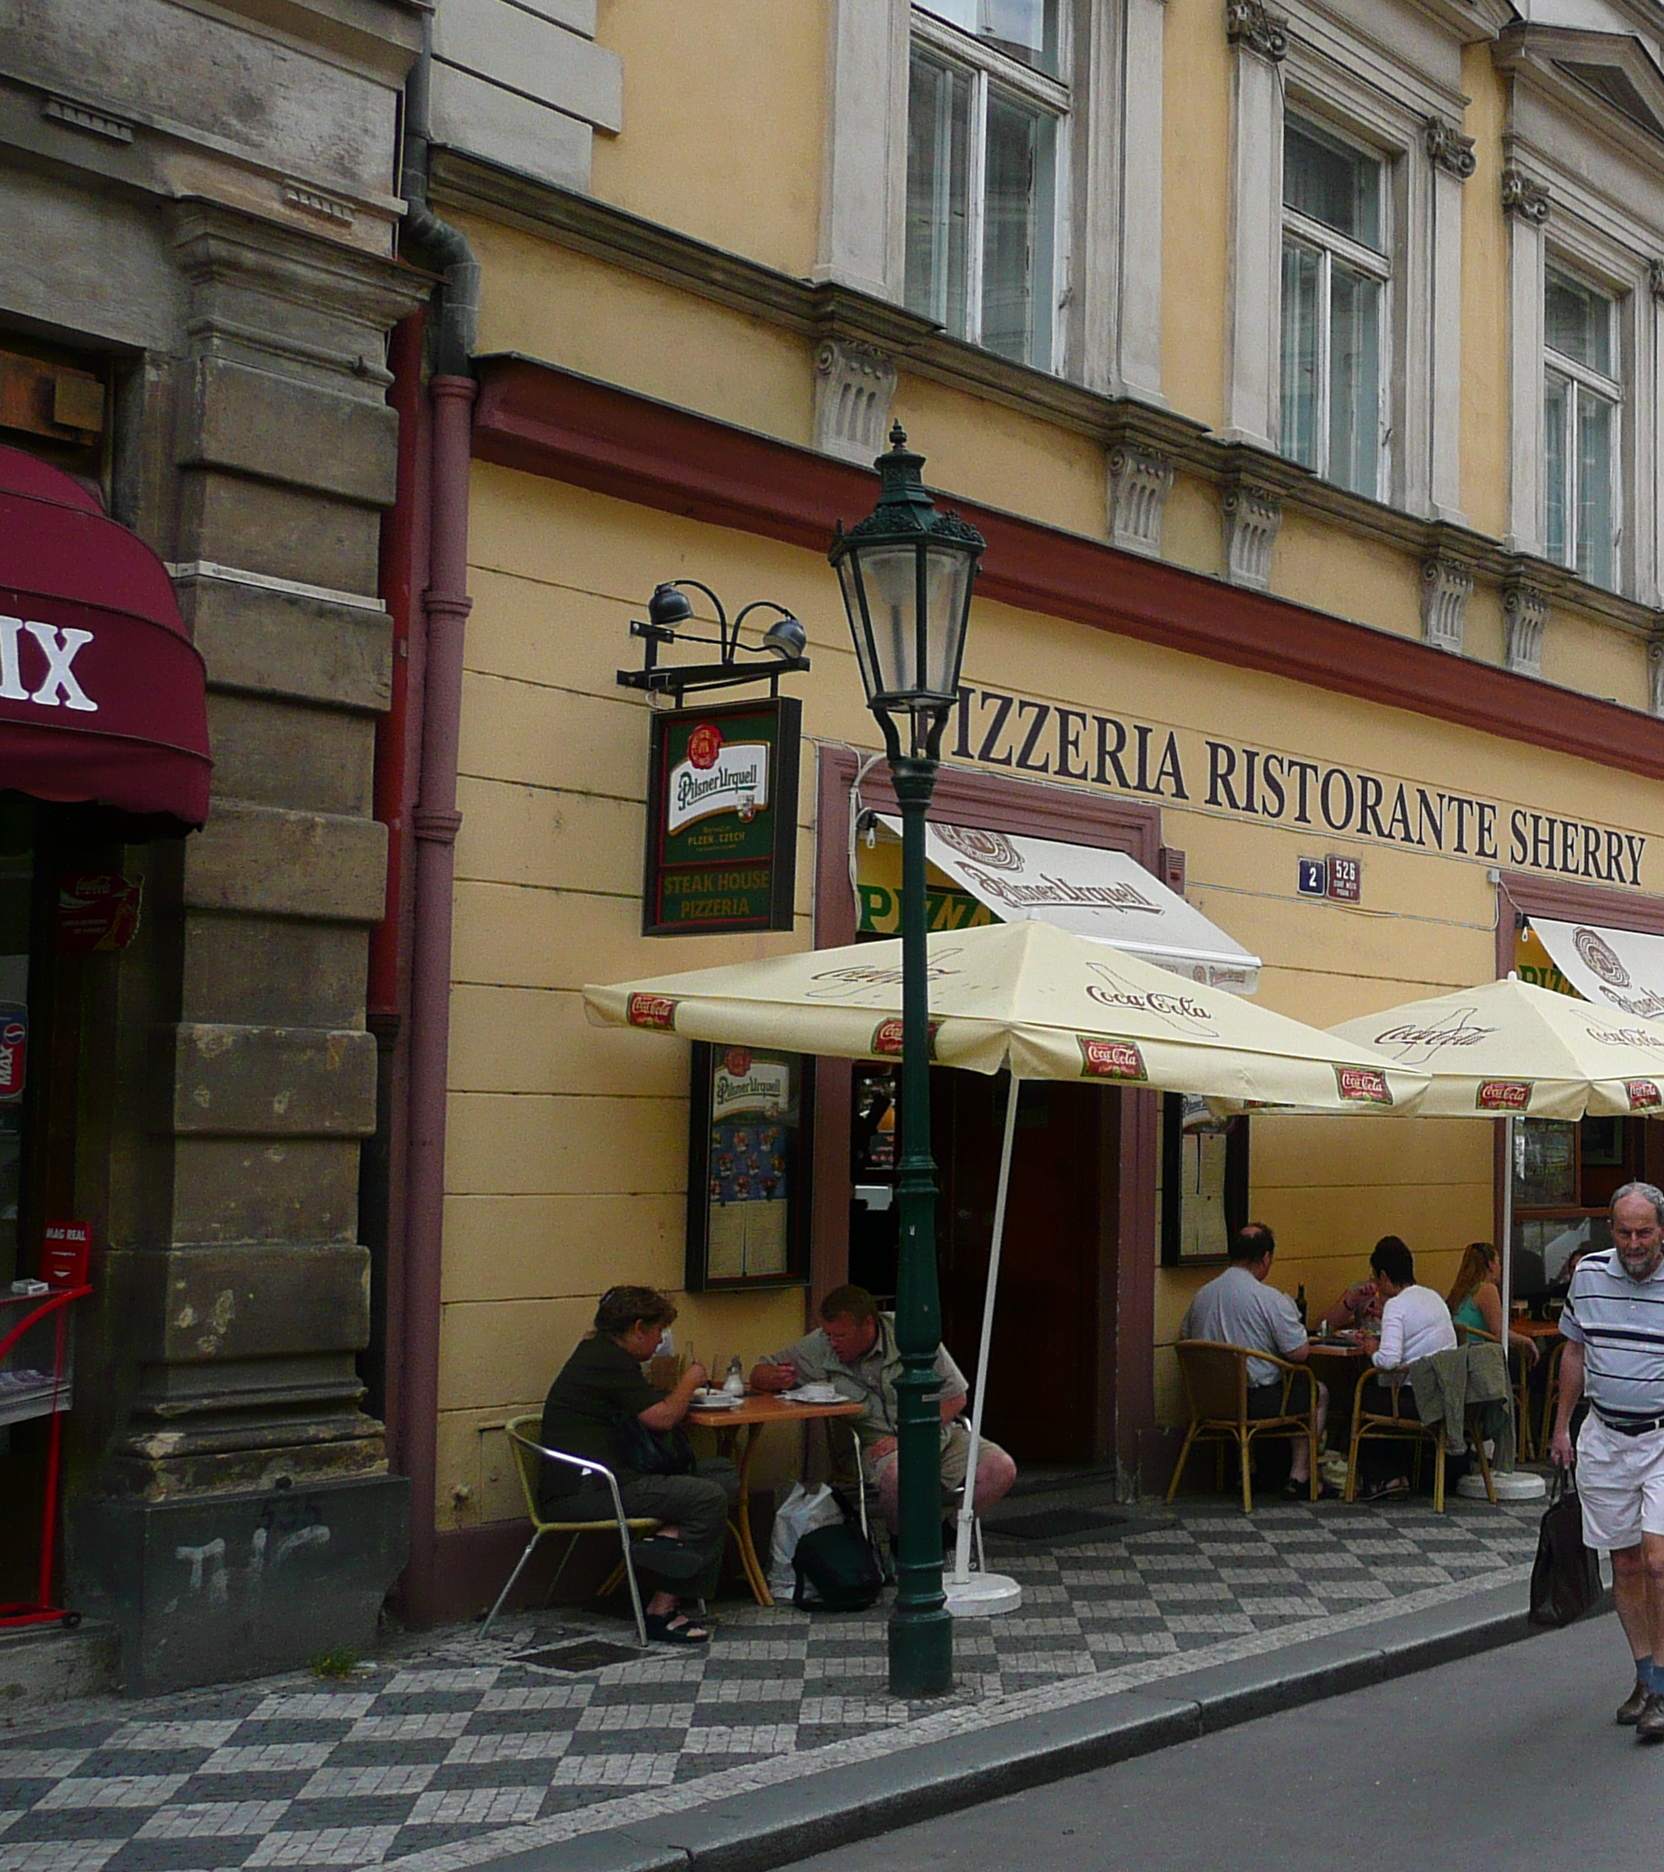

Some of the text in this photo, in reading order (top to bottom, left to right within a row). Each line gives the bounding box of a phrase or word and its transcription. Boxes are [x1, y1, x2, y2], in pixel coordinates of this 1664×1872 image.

[677, 764, 757, 811] Pilsner Urquell
[1205, 740, 1497, 859] RISTORANTE
[1511, 809, 1646, 886] SHERRY
[1309, 867, 1317, 887] 2
[1335, 860, 1356, 880] 526
[664, 869, 769, 895] STEAK HOUSE
[680, 898, 749, 918] PIZZERIA
